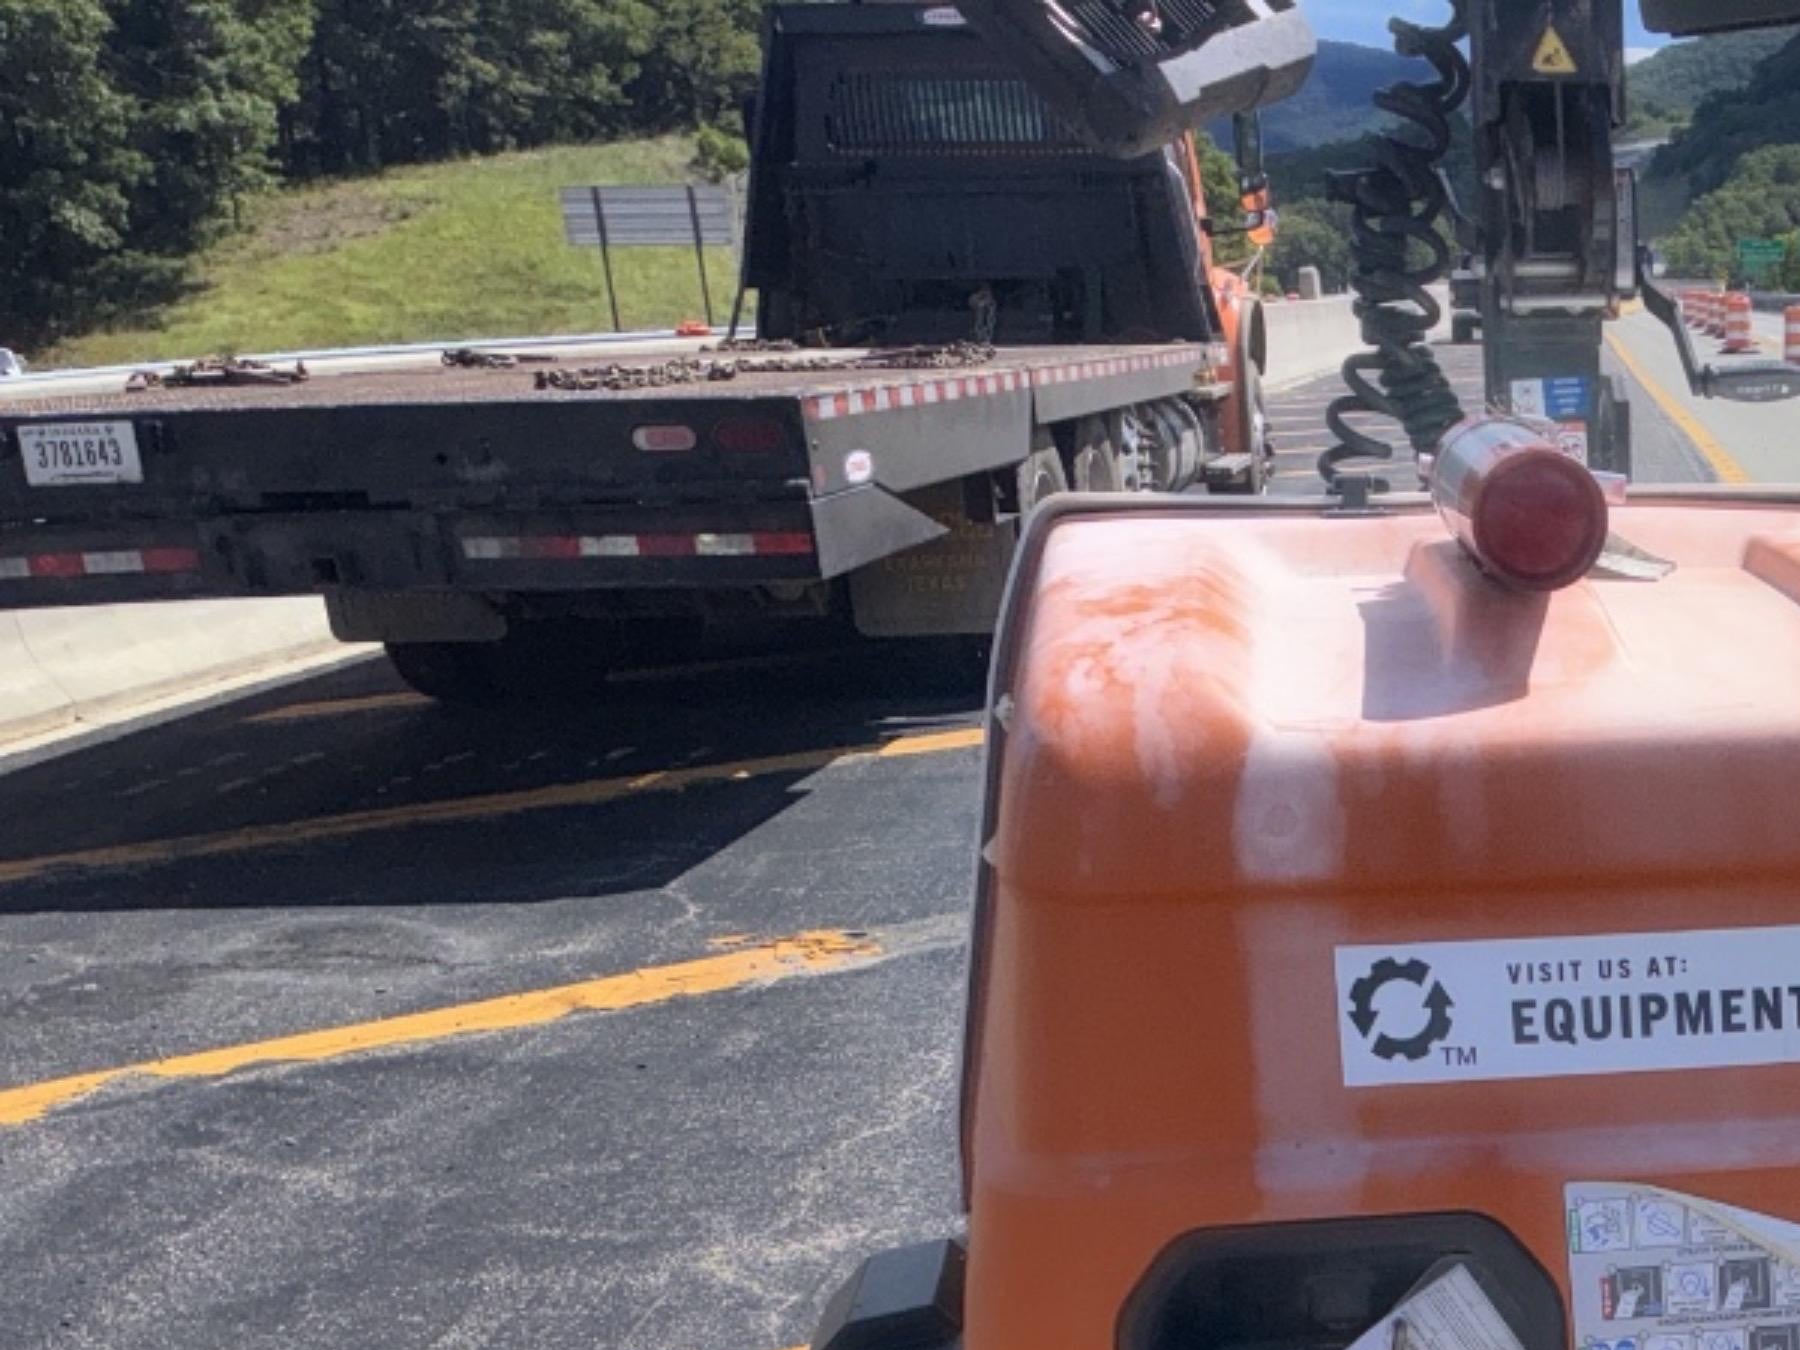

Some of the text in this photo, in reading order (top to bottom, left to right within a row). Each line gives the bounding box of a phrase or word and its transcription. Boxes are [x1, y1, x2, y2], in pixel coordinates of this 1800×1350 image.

[1506, 956, 1687, 984] VISIT US AT:
[1440, 1045, 1477, 1066] TM
